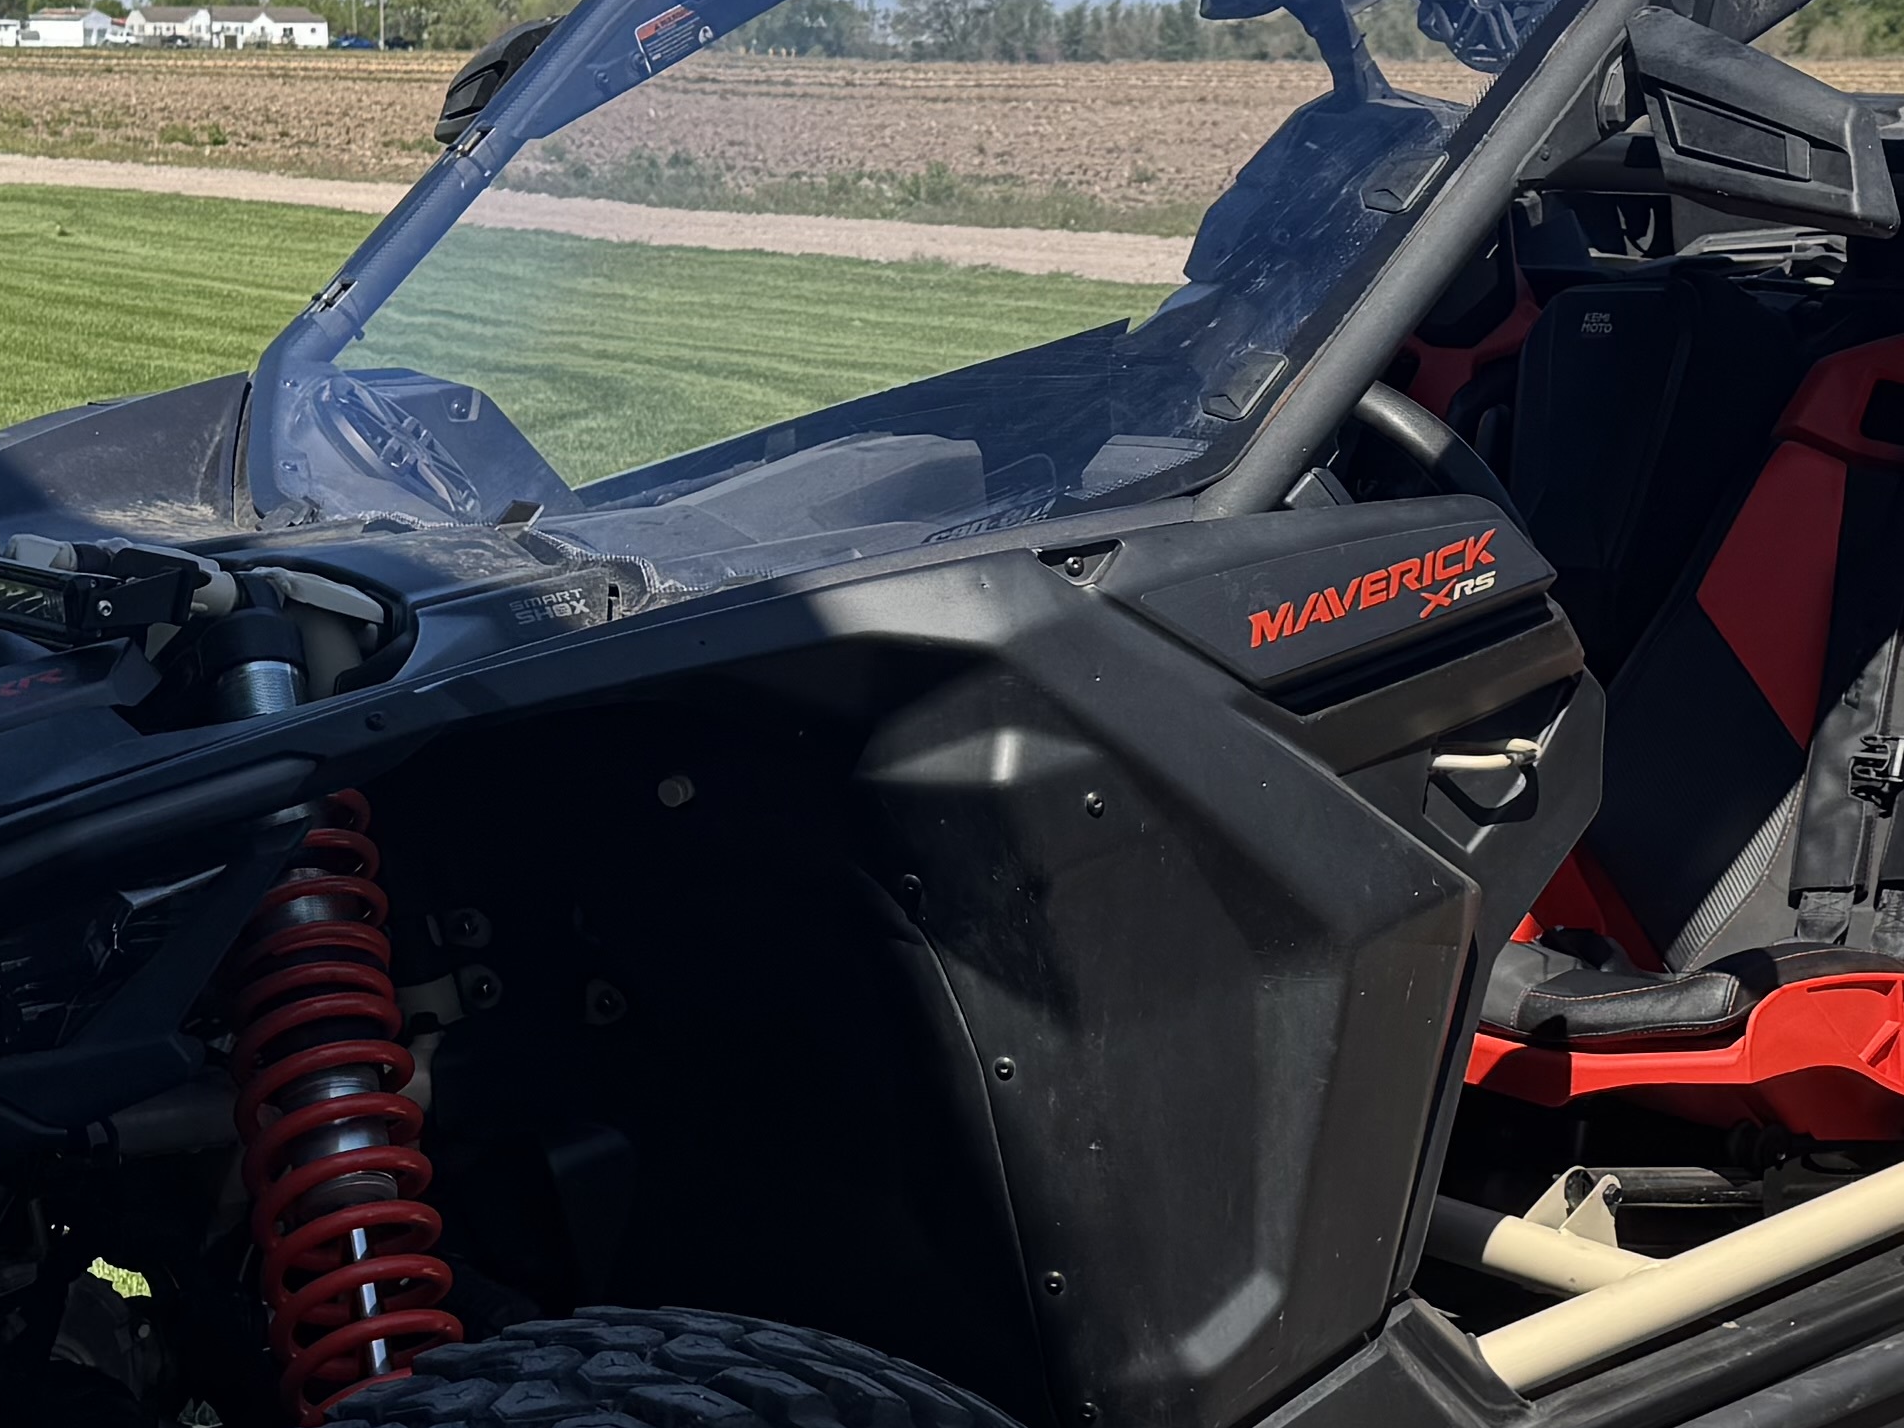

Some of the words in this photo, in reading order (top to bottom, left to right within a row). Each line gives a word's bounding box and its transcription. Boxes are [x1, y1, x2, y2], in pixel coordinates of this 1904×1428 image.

[1581, 322, 1613, 333] MOTO
[1584, 312, 1611, 322] KEMI
[509, 588, 583, 612] SMART
[1248, 527, 1497, 648] MAVERICK
[1418, 570, 1498, 619] XRS
[515, 598, 590, 625] SHOX
